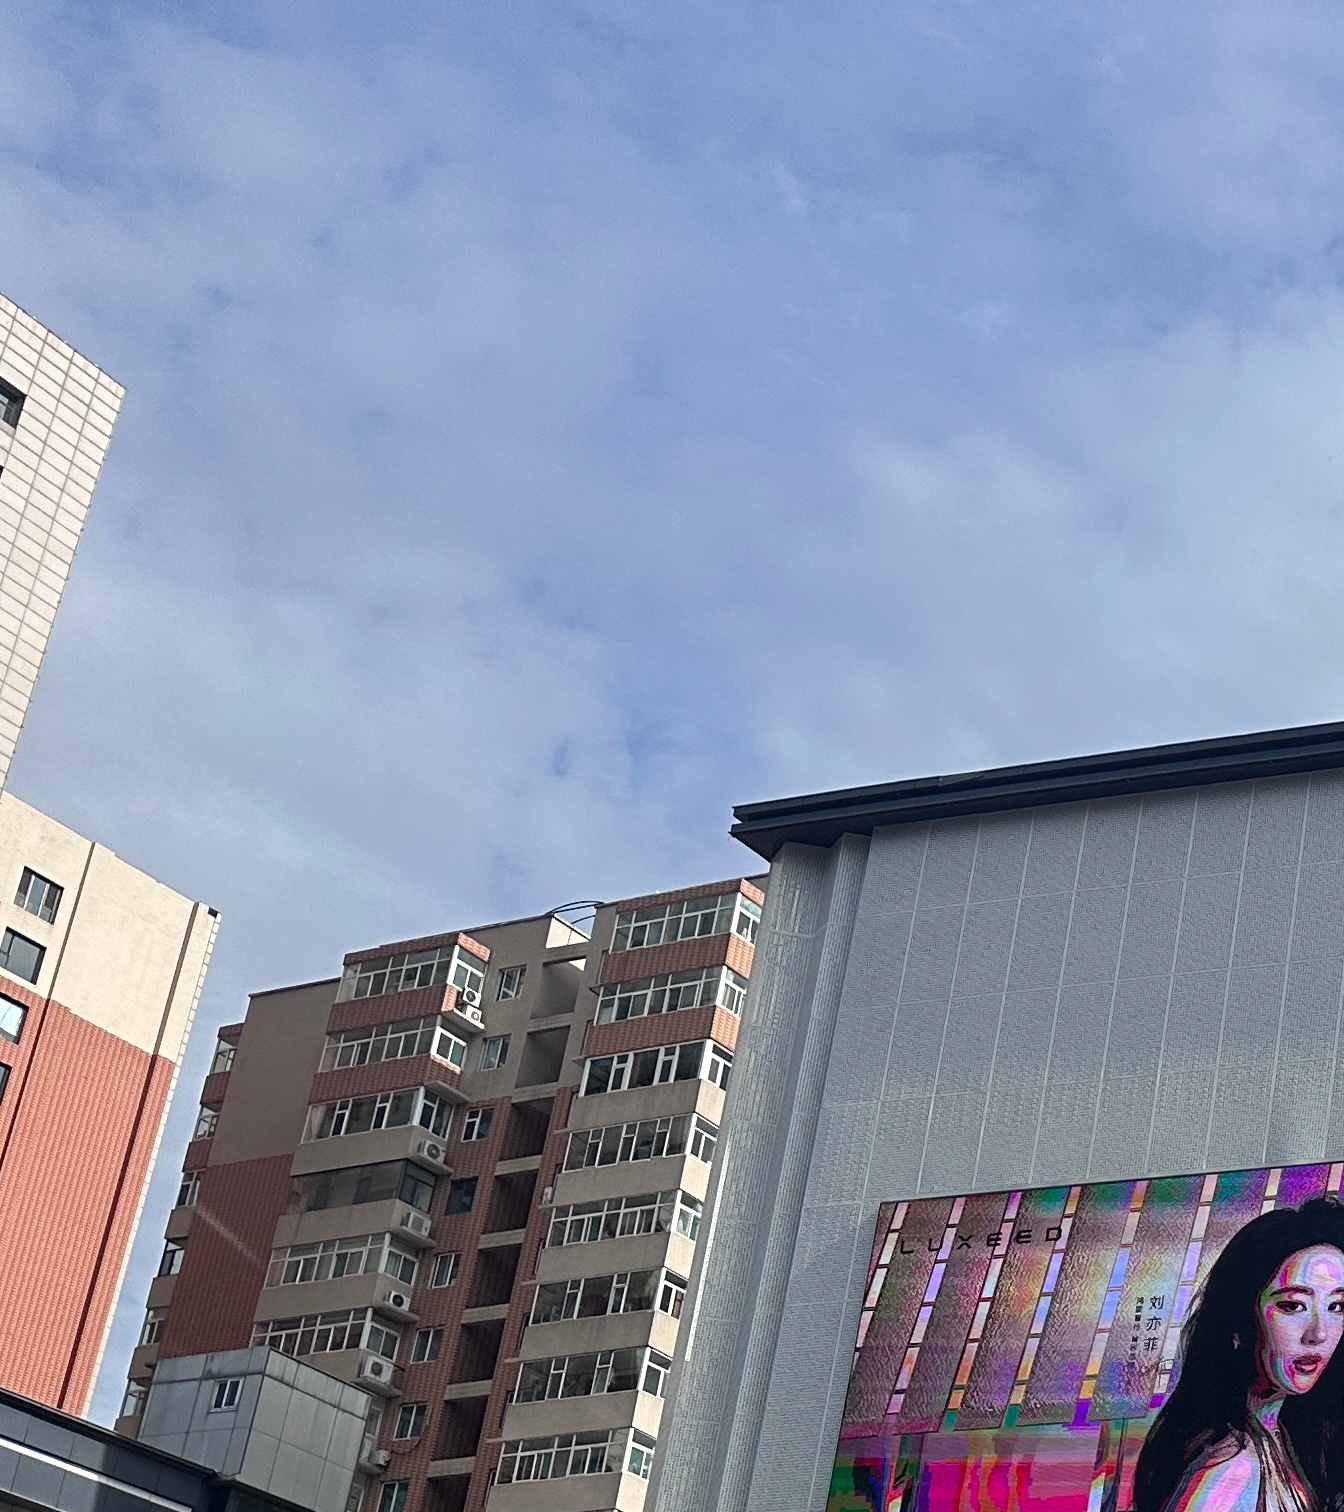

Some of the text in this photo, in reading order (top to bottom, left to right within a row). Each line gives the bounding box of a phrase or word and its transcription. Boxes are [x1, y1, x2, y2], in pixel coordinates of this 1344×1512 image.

[899, 1227, 1063, 1255] LUXEED
[1143, 1294, 1166, 1352] 刘亦菲
